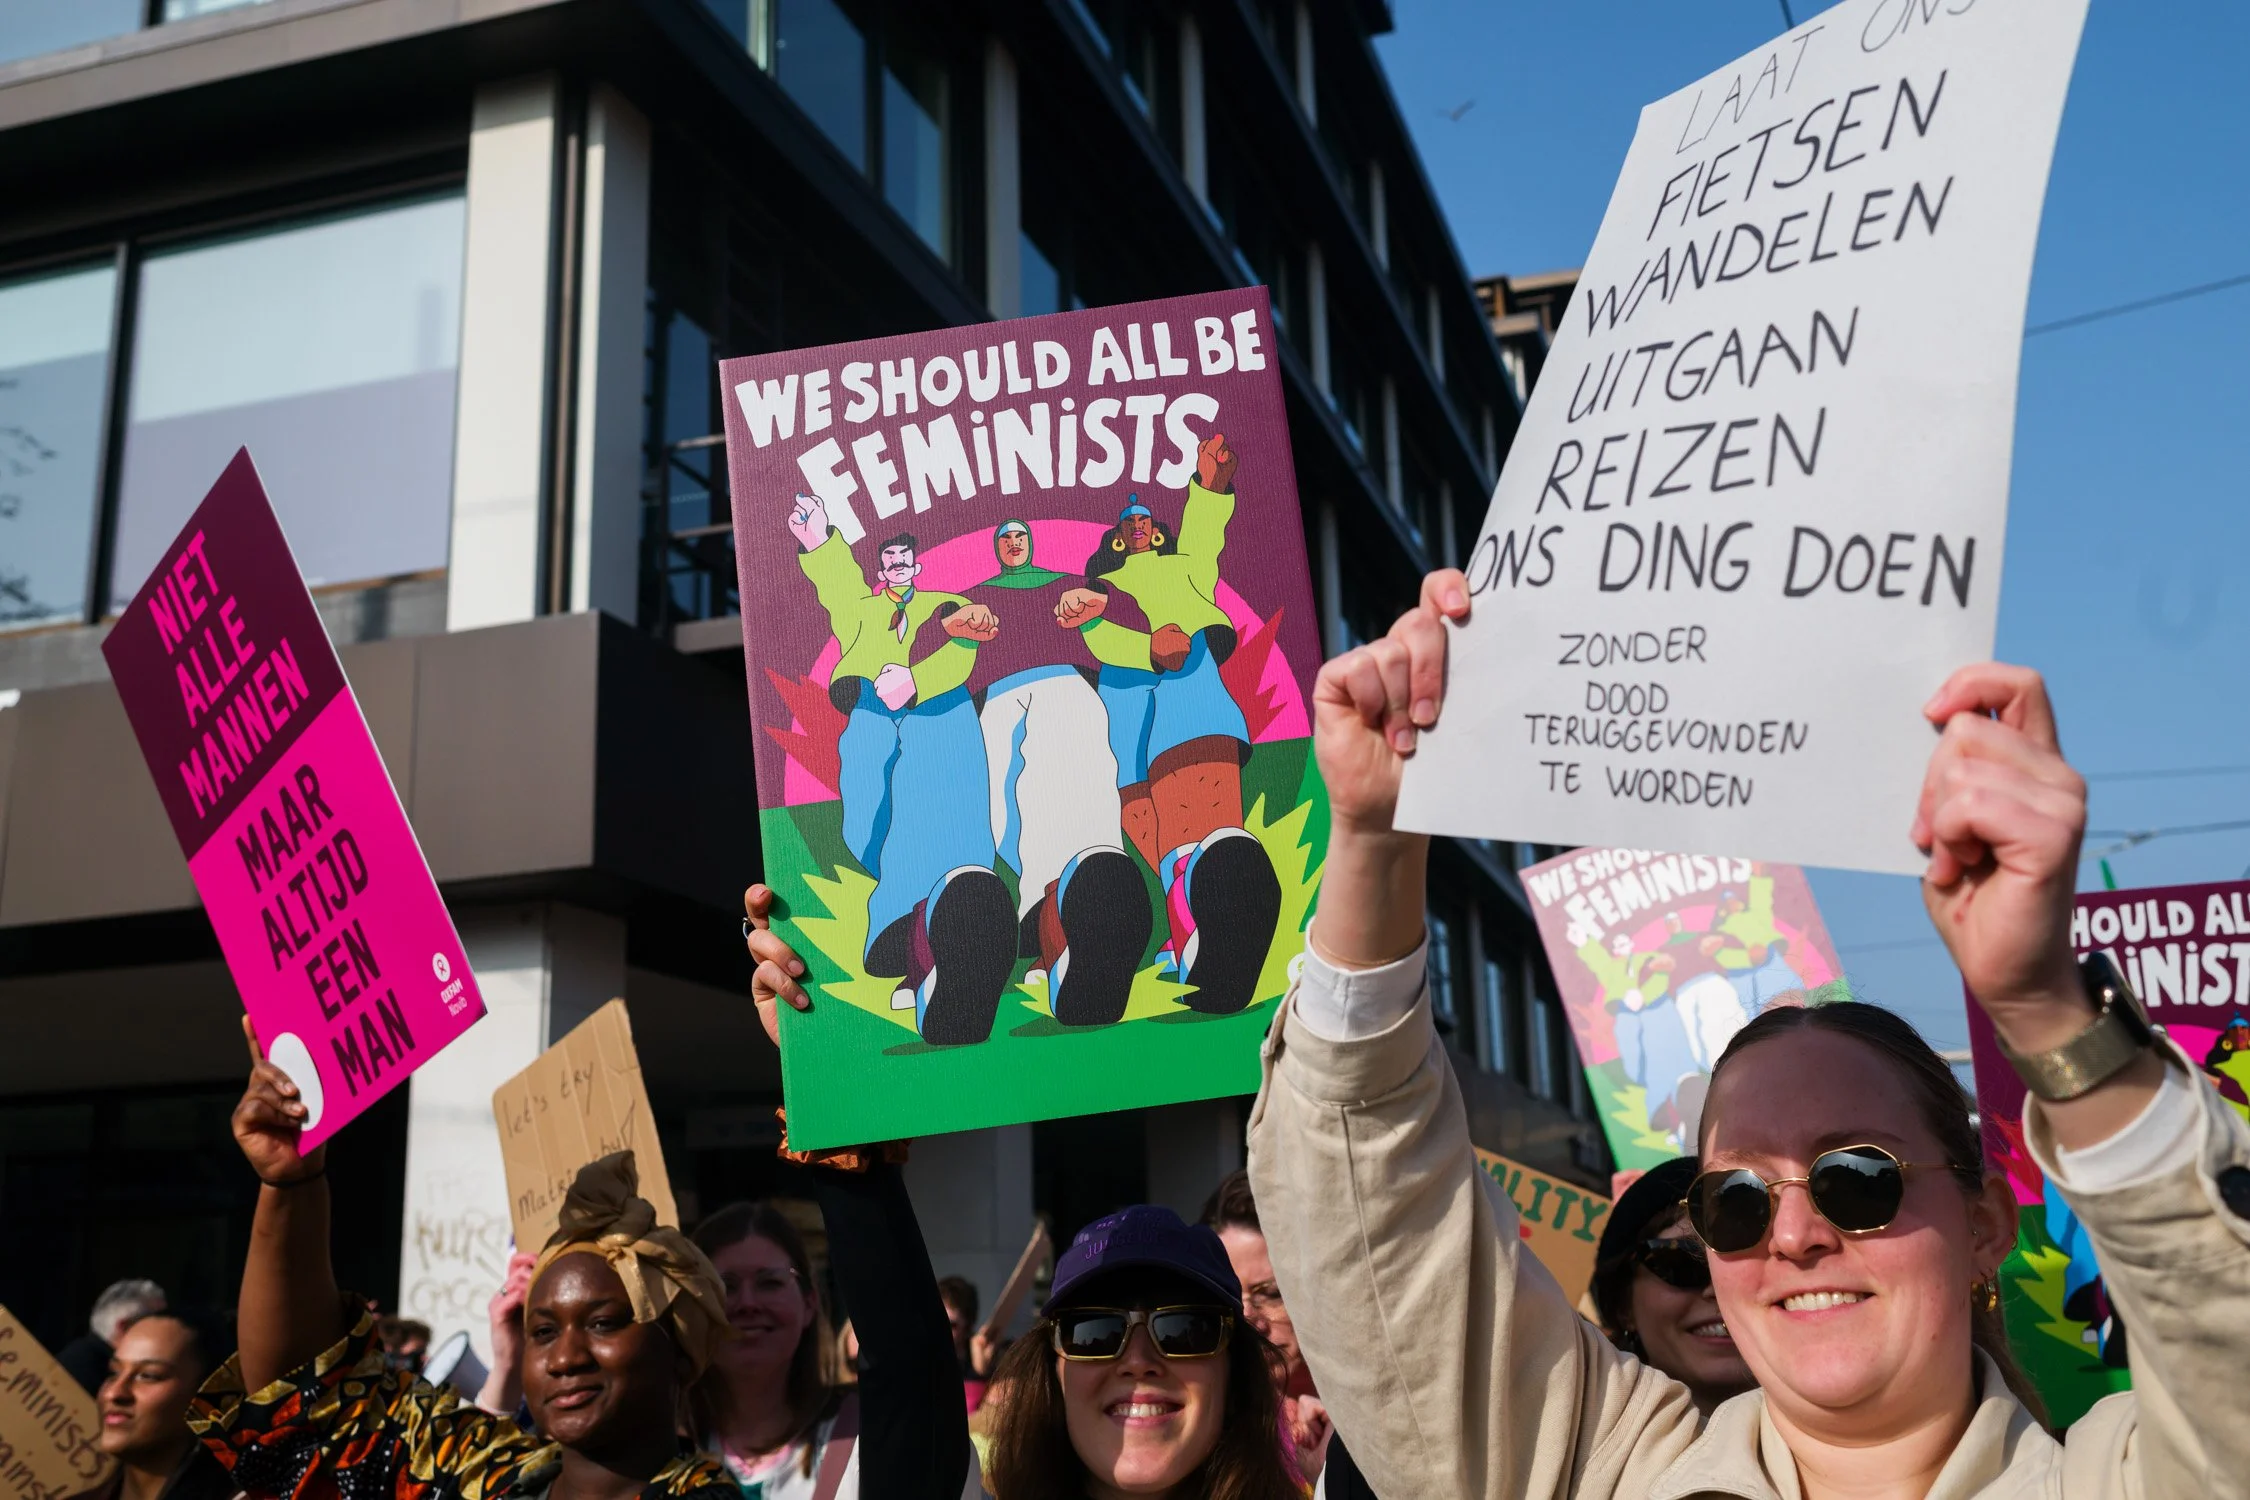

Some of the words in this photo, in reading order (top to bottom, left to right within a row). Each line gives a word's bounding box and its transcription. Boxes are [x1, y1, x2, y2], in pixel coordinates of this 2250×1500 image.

[1676, 25, 1825, 155] LAAT
[1646, 69, 1947, 242] FIETSEN
[1587, 176, 1954, 338] WANDELEN
[734, 368, 832, 448] WE
[840, 340, 1071, 424] SHOULD
[1088, 321, 1189, 386] ALL
[1194, 308, 1267, 377] BE
[1567, 306, 1859, 424] UITGAAN
[1535, 407, 1826, 514] REIZEN
[148, 529, 218, 655] NIET
[1468, 524, 1564, 598] ONS
[1599, 521, 1753, 592] DING
[1783, 524, 1976, 608] DOEN
[176, 596, 256, 729] ALLE
[1558, 625, 1707, 668] ZONDER
[1586, 681, 1669, 716] DOOD
[179, 637, 309, 819] MANNEN
[1524, 713, 1809, 754] TERUGGEVONDEN
[235, 763, 335, 894] MAAR
[1539, 761, 1582, 794] TE
[1606, 766, 1753, 809] WORDEN
[261, 827, 369, 972] ALTIJD
[1528, 862, 1578, 907] WE
[1575, 848, 1666, 887] SHOU
[2070, 899, 2194, 948] HOULD
[2204, 892, 2250, 936] AL
[304, 918, 381, 1022] EEN
[441, 977, 464, 1004] OXFAM
[331, 988, 416, 1097] MAN
[1480, 1159, 1607, 1242] ALITY
